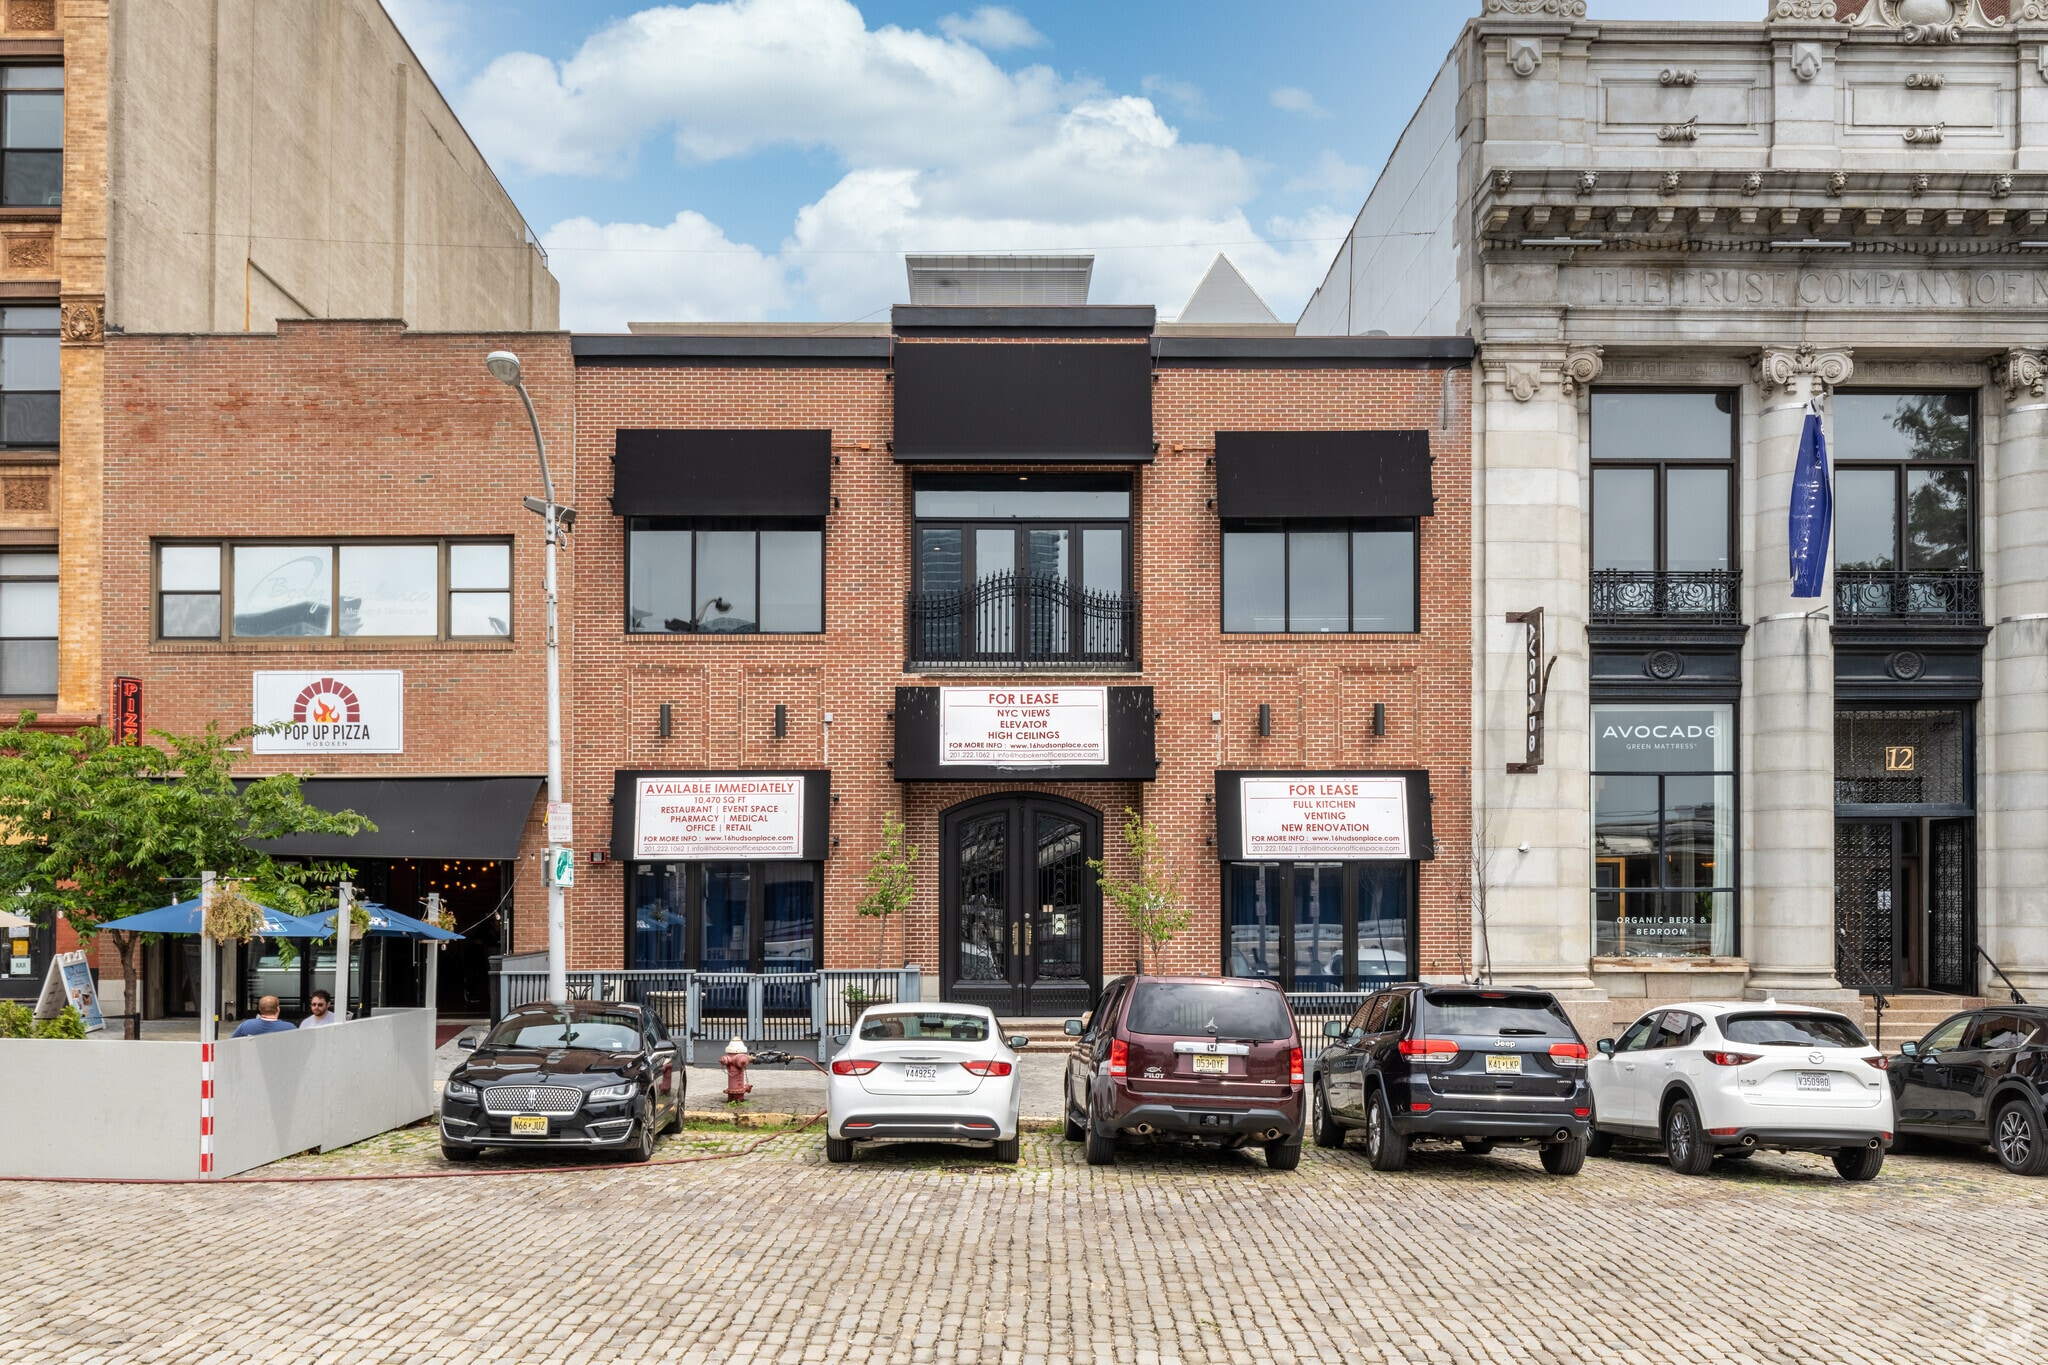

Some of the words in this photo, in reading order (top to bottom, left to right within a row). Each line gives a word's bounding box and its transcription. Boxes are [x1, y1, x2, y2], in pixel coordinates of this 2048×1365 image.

[1593, 270, 1664, 303] THE
[1675, 271, 1786, 303] TRUST
[1799, 271, 1965, 304] COMPANY
[1975, 271, 2025, 304] OF
[1528, 624, 1536, 752] AVOCADO
[989, 693, 1016, 705] FOR
[1020, 693, 1059, 704] LEASE
[997, 709, 1018, 718] NYC
[1021, 709, 1051, 717] VIEWS
[1000, 720, 1048, 729] ELEVATOR
[284, 725, 309, 740] POP
[312, 725, 330, 740] UP
[333, 725, 370, 740] PIZZA
[988, 731, 1013, 740] HIGH
[1016, 731, 1060, 740] CEILINGS
[1602, 725, 1721, 738] AVOCADO
[1010, 742, 1099, 750] www.16hudsonplace.com
[1887, 748, 1914, 769] 12
[646, 783, 711, 794] AVAILABLE
[714, 782, 794, 794] IMMEDIATELY
[1289, 784, 1315, 796] FOR
[1320, 784, 1359, 795] LEASE
[694, 796, 721, 804] 10,470
[723, 796, 735, 804] SQ
[737, 796, 746, 804] FT
[1293, 800, 1313, 809] FULL
[1316, 800, 1356, 808] KITCHEN
[661, 805, 713, 814] RESTAURANT
[722, 805, 750, 813] EVENT
[751, 805, 779, 813] SPACE
[670, 815, 719, 823] PHARMACY
[729, 814, 768, 823] MEDICAL
[1304, 811, 1347, 820] VENTING
[686, 824, 716, 832] OFFICE
[725, 824, 753, 832] RETAIL
[1281, 823, 1303, 832] NEW
[1306, 823, 1370, 832] RENOVATION
[704, 834, 794, 843] www.16hudsonplace.com
[1312, 835, 1400, 843] www.16hudsonplace.com
[1616, 916, 1664, 924] ORGANIC
[1669, 916, 1695, 924] BEDS
[1700, 916, 1707, 924] &
[1636, 928, 1687, 936] BEDROOM
[1494, 1039, 1516, 1048] Jeep
[905, 1069, 937, 1078] V449252
